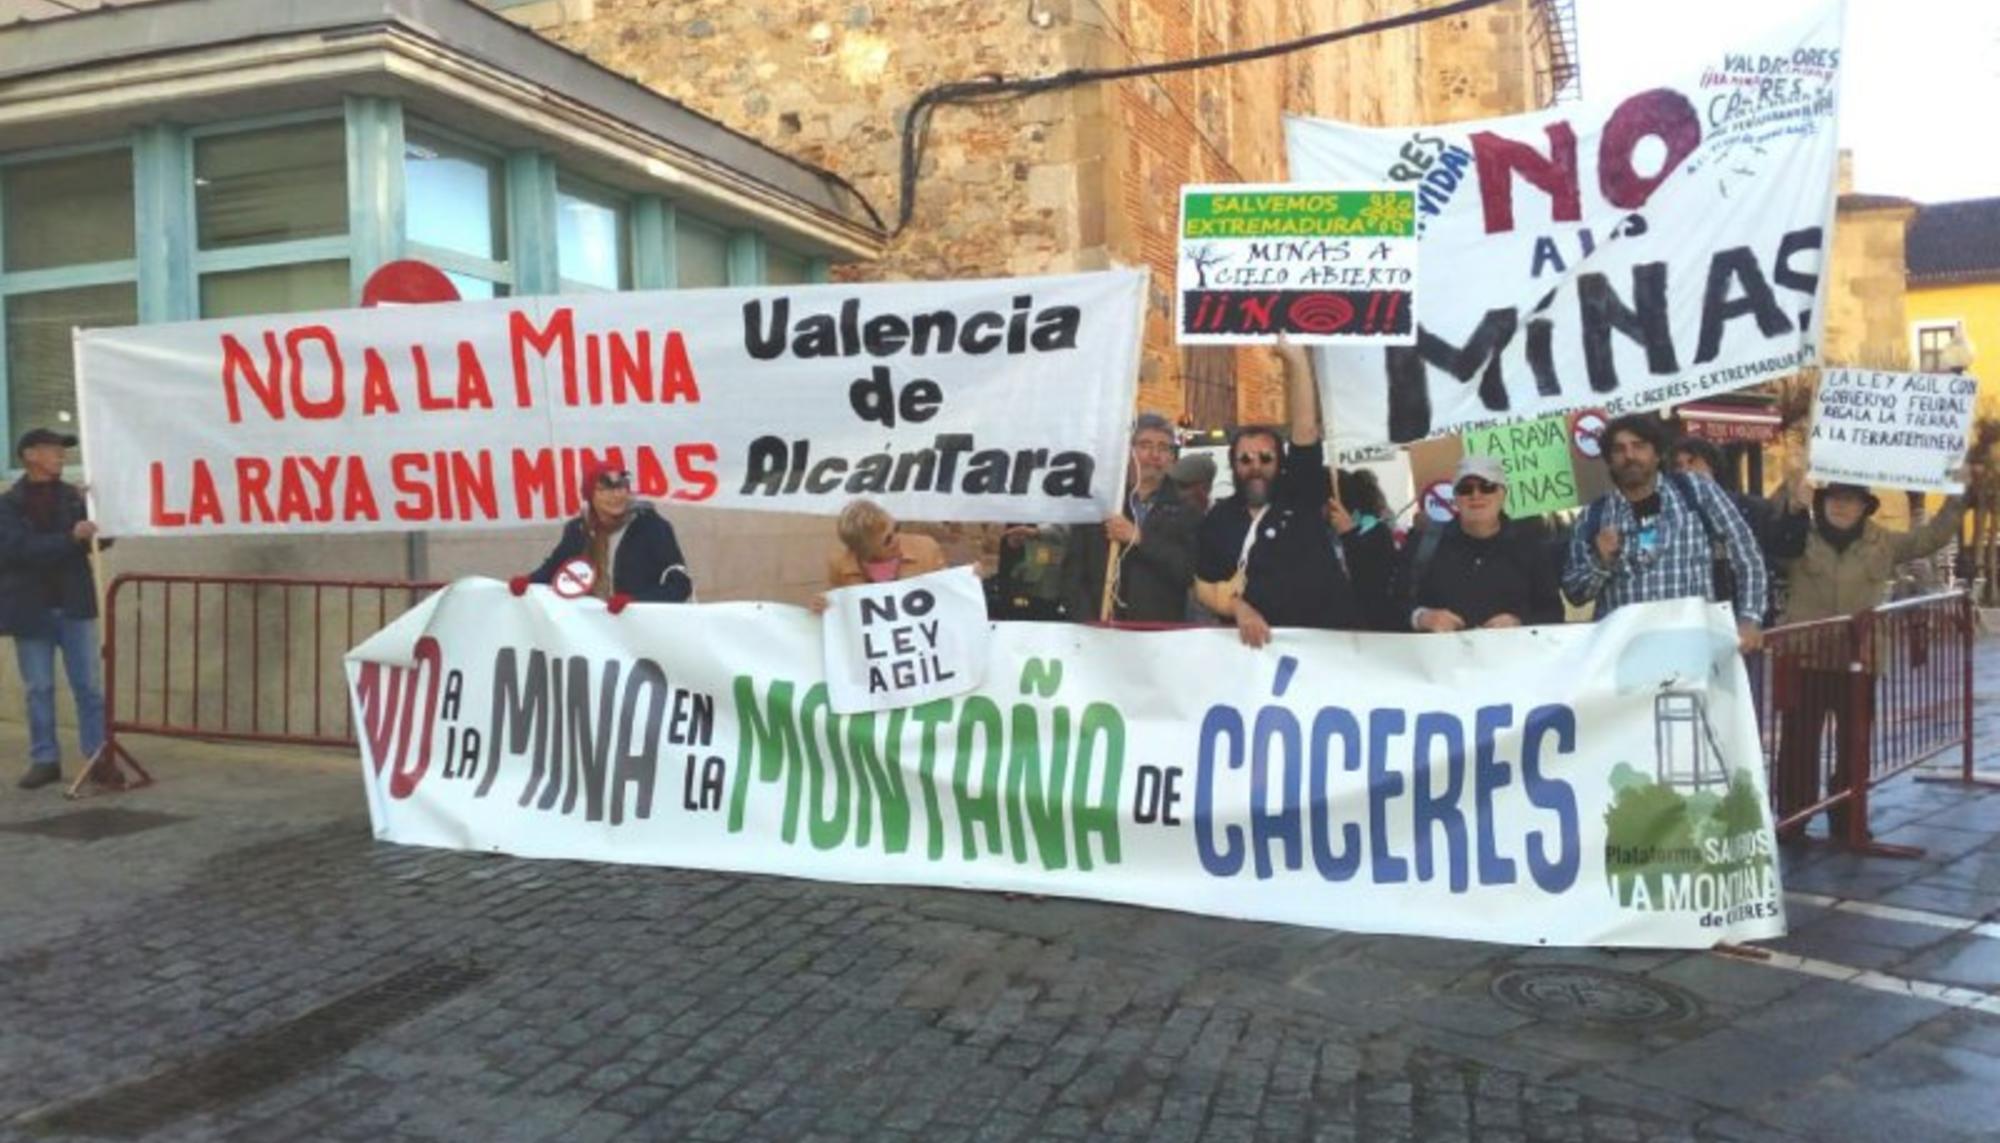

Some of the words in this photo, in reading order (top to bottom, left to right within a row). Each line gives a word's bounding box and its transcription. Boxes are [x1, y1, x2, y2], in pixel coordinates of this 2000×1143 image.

[1468, 88, 1702, 234] NO
[1211, 194, 1339, 214] SALVEMOS
[1186, 217, 1366, 236] EXTREMADURA
[1247, 241, 1351, 263] MINAS
[1368, 241, 1392, 261] A
[1531, 236, 1566, 277] A
[1214, 266, 1289, 287] CIELO
[1300, 265, 1412, 288] ABIERTO
[220, 324, 346, 424] NO
[362, 346, 399, 415] A
[411, 340, 493, 411] LA
[509, 307, 700, 408] MINA
[1828, 371, 1851, 387] LA
[1856, 372, 1897, 389] LEY
[1949, 378, 1978, 395] CON
[849, 365, 943, 429] de
[1819, 389, 1898, 409] GOBIERNO
[1509, 421, 1566, 451] RAYA
[1812, 426, 1821, 438] A
[1829, 427, 1846, 441] LA
[1877, 411, 1896, 424] LA
[1906, 412, 1959, 429] TIERRA
[1502, 452, 1539, 474] SIN
[150, 460, 224, 527] LA
[236, 453, 380, 524] RAYA
[391, 449, 499, 522] SIN
[1508, 470, 1574, 512] INAS
[860, 588, 936, 625] NO
[864, 620, 939, 659] LEY
[441, 669, 464, 721] A
[357, 635, 442, 800] NO
[474, 647, 668, 827] MINA
[668, 689, 714, 746] EN
[442, 727, 481, 780] LA
[728, 657, 1126, 872] MONTAÑA
[683, 754, 726, 811] LA
[1194, 655, 1581, 894] CÁCERES
[1134, 765, 1183, 826] DE
[1699, 912, 1723, 928] de
